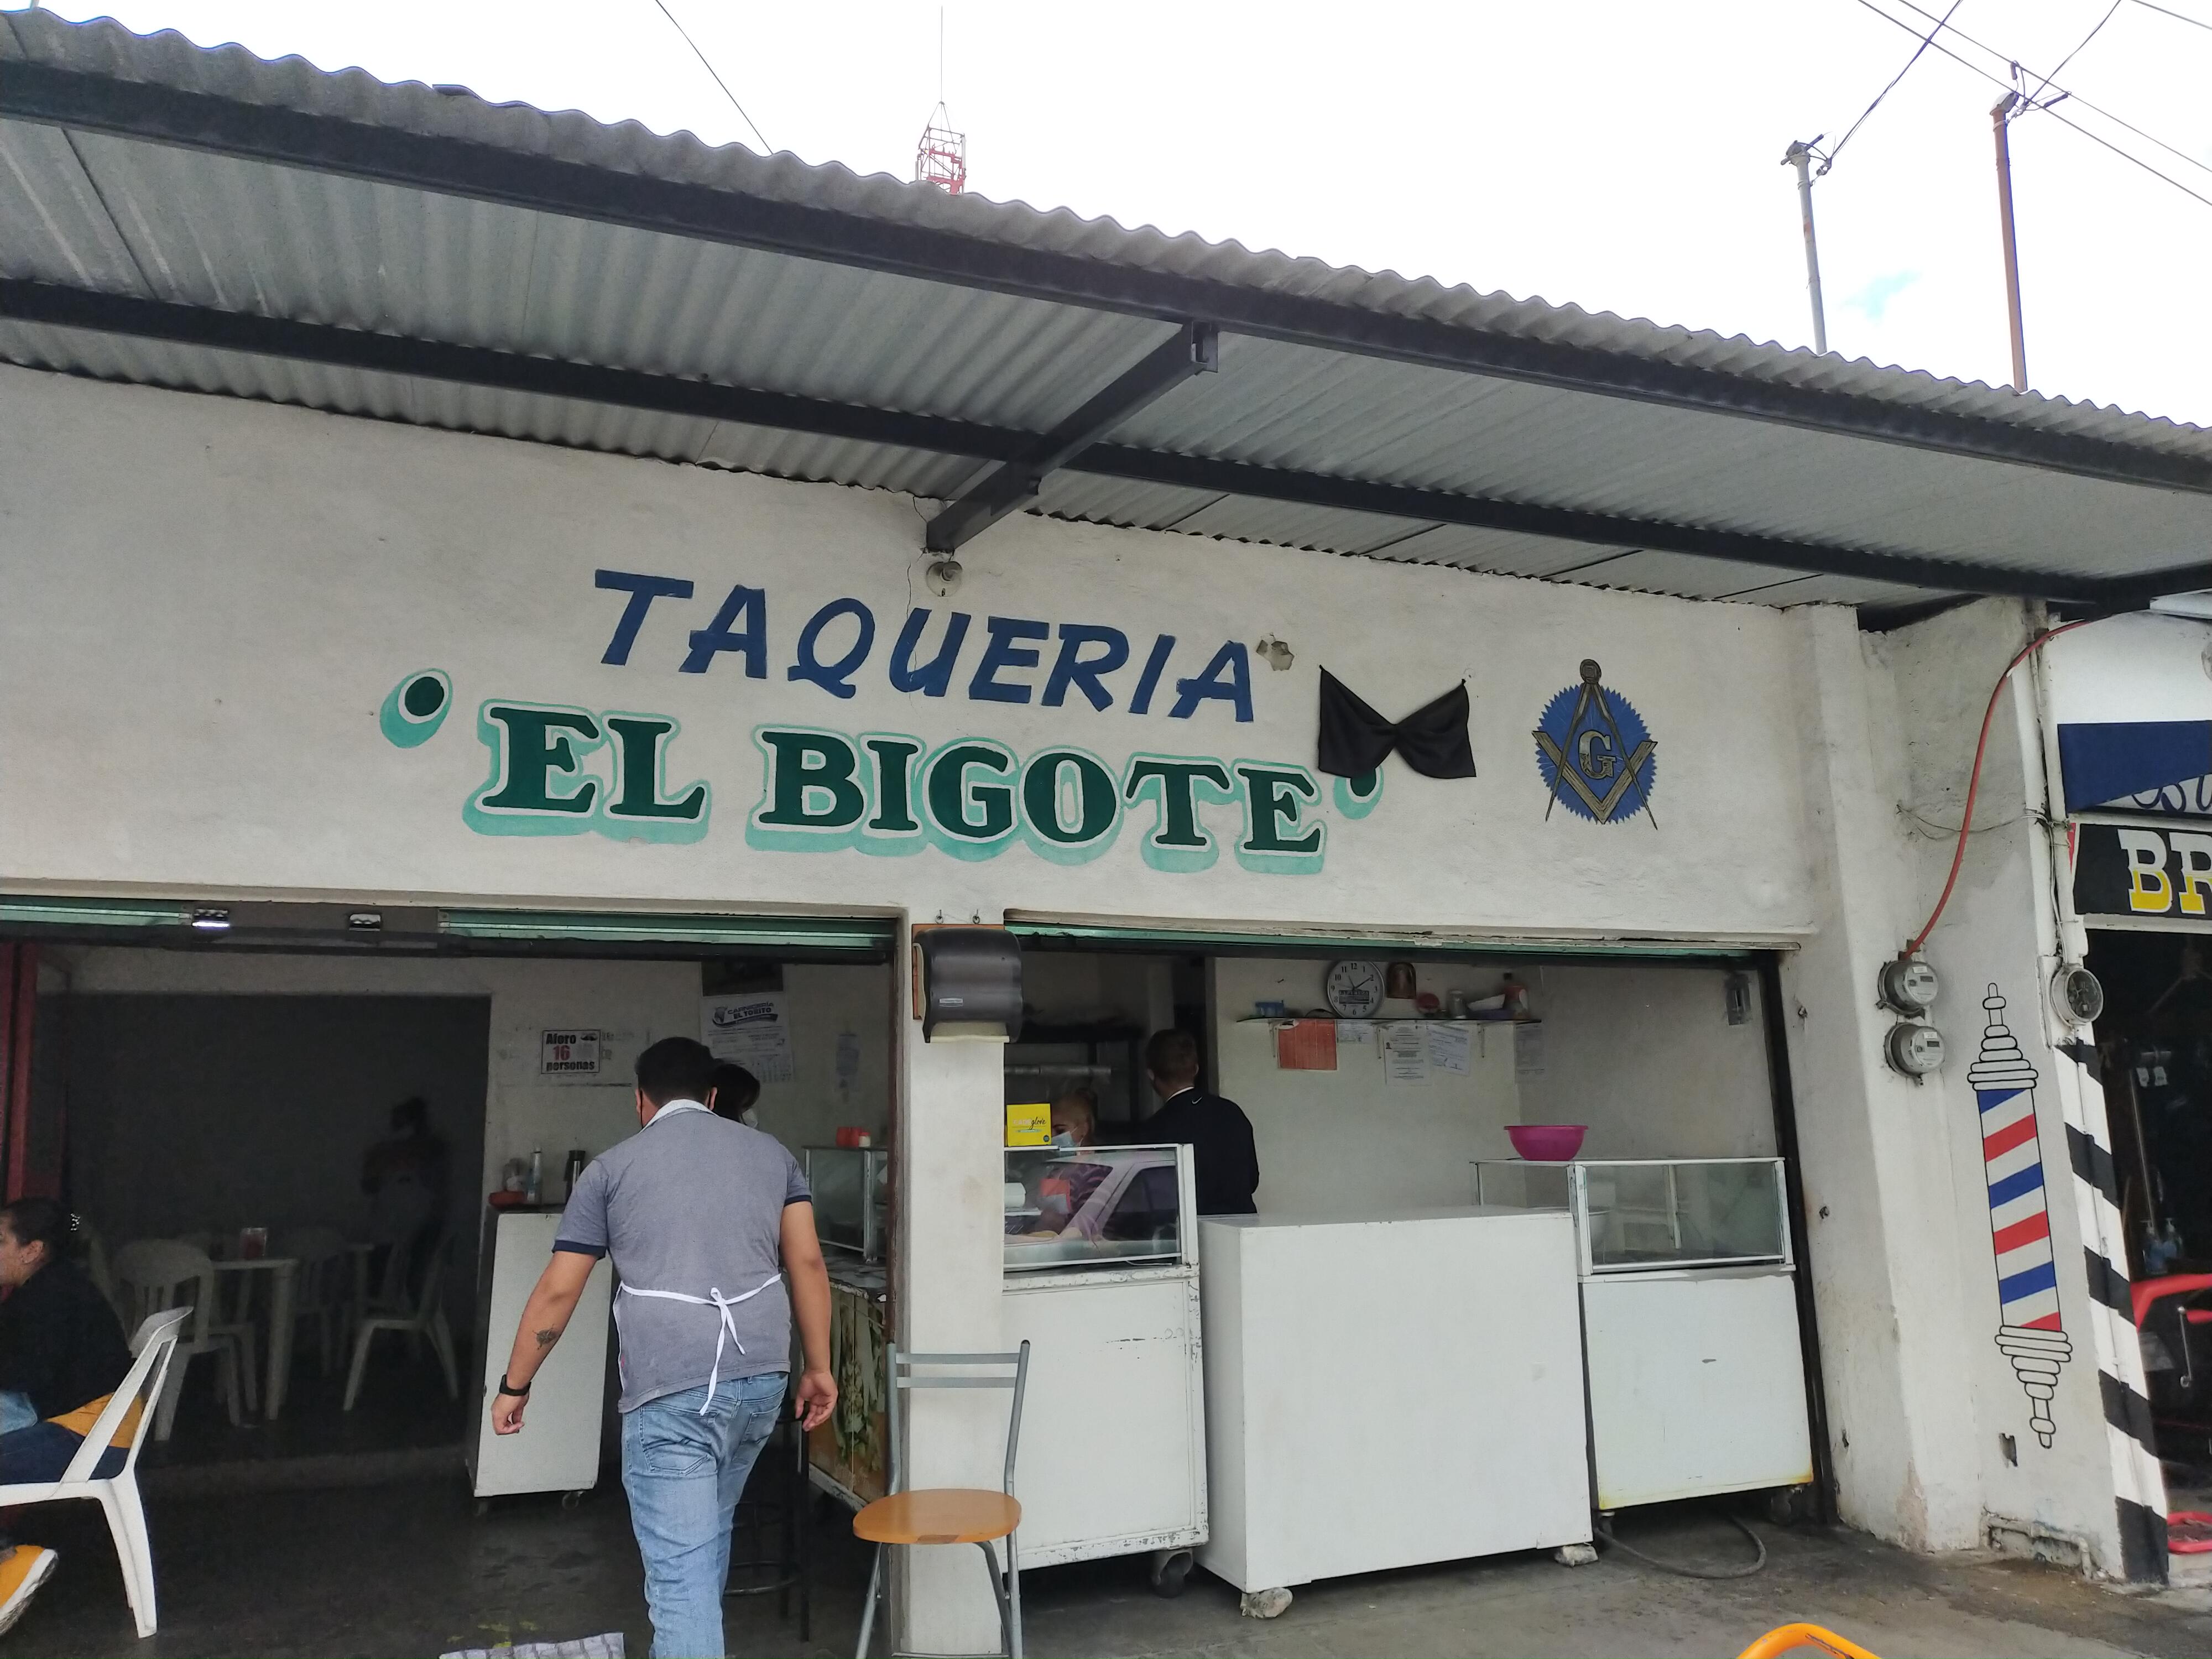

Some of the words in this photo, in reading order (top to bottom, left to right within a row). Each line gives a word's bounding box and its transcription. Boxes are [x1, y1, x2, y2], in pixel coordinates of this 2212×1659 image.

[594, 568, 1254, 723] TAQUERIA
[1579, 729, 1617, 780] G
[470, 702, 709, 832] EL
[752, 727, 1324, 865] BIGOTE
[546, 1033, 577, 1045] Aforo
[553, 1045, 571, 1061] 16
[546, 1061, 595, 1072] personas
